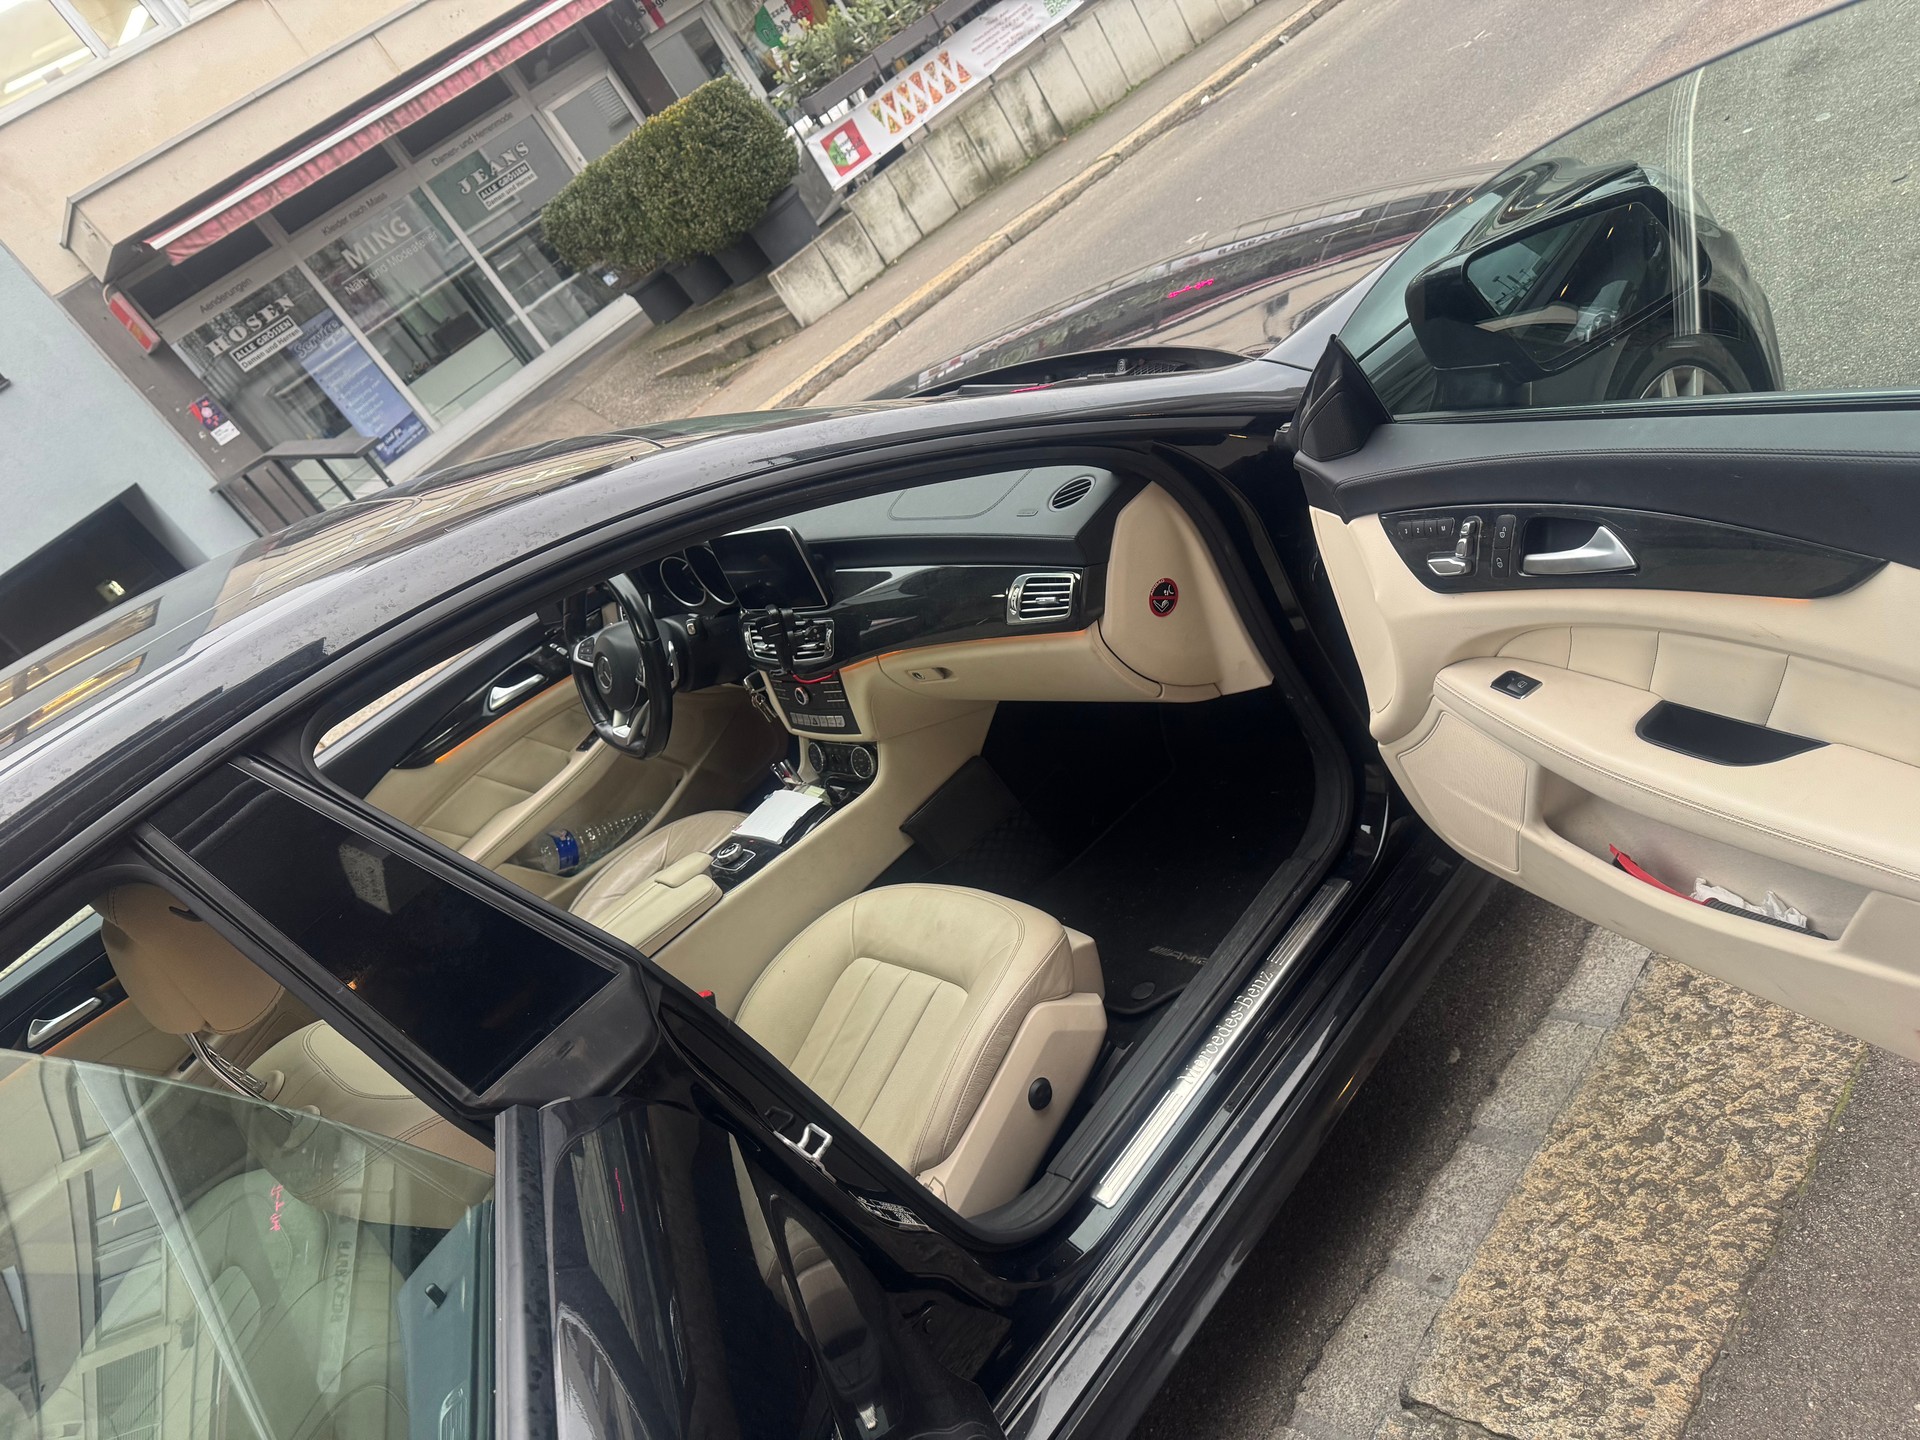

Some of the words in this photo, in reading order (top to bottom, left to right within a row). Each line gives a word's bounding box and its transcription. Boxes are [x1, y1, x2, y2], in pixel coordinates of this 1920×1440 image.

[431, 146, 459, 166] Damen-
[459, 135, 474, 149] und
[472, 111, 513, 140] Herrenmode
[458, 141, 529, 194] JEANS
[481, 181, 499, 199] ALLE
[485, 193, 505, 207] Damen
[505, 184, 517, 195] und
[321, 216, 349, 236] Kleider
[348, 203, 367, 219] nach
[341, 215, 412, 270] MING
[344, 276, 369, 296] Näh-
[369, 263, 388, 280] und
[386, 231, 438, 266] Modeatelier
[200, 278, 252, 314] Aenderungen
[205, 293, 295, 358] HOSEN
[234, 341, 258, 360] ALLE
[256, 318, 293, 346] GRÖSSEN
[293, 319, 340, 359] Service
[241, 351, 266, 369] Damen
[265, 341, 279, 355] und
[278, 328, 300, 347] Herren
[1177, 969, 1274, 1085] Mercedes-Benz
